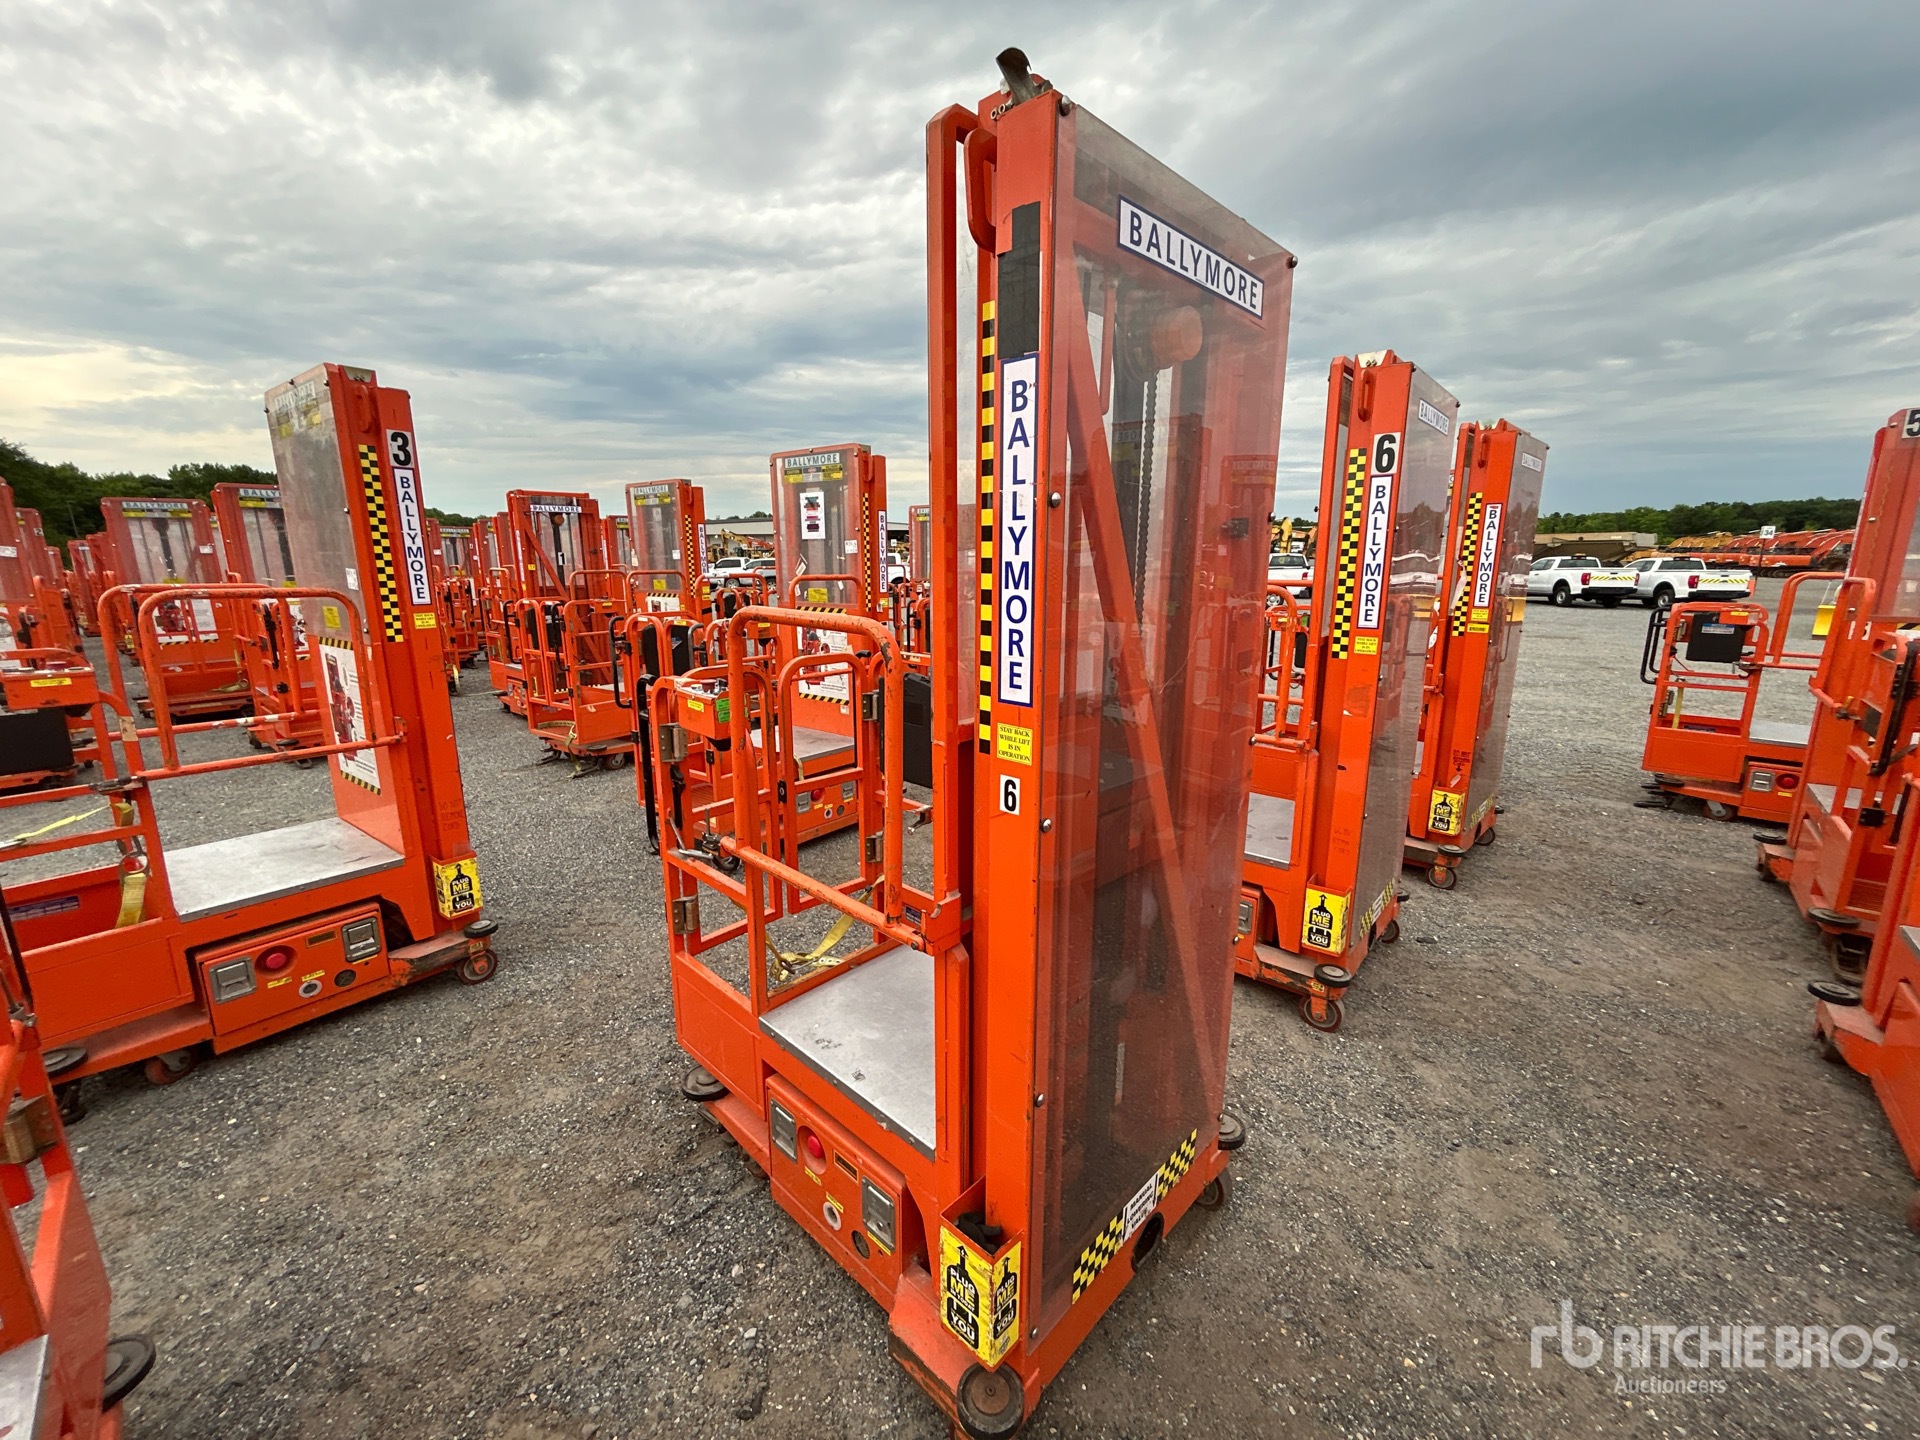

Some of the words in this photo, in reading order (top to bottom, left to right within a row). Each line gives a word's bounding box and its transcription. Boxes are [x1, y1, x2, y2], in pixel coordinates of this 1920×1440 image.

[1129, 209, 1259, 310] BALLYMORE
[1420, 402, 1448, 433] BALLYMORE
[390, 431, 412, 466] 3
[1375, 434, 1396, 473] 6
[787, 454, 837, 467] BALLYMORE
[36, 528, 42, 536] 2
[400, 475, 426, 599] BALLYMORE
[1003, 378, 1030, 690] BALLYMORE
[560, 553, 565, 565] 1
[1363, 485, 1386, 622] BALLYMORE
[1478, 509, 1498, 603] BALLYMORE
[999, 733, 1017, 743] WHILE
[1018, 738, 1031, 746] LIFT
[1000, 726, 1013, 734] STAY
[1014, 729, 1030, 738] BACK
[998, 750, 1031, 762] OPERATION
[1014, 744, 1021, 752] IN
[1004, 779, 1017, 812] 6
[1436, 807, 1450, 815] ME
[452, 878, 469, 886] PLUG
[453, 883, 470, 892] ME
[455, 900, 473, 909] YOU
[1312, 909, 1331, 919] PLUG
[1312, 914, 1330, 926] ME
[1310, 934, 1328, 944] YOU
[1127, 1191, 1154, 1224] LOWERING
[1130, 1183, 1153, 1211] MANUAL
[950, 1267, 976, 1295] PLUG
[950, 1276, 976, 1307] ME
[996, 1274, 1015, 1296] PLUG
[996, 1284, 1015, 1307] ME
[950, 1311, 976, 1340] YOU
[996, 1309, 1014, 1332] YOU
